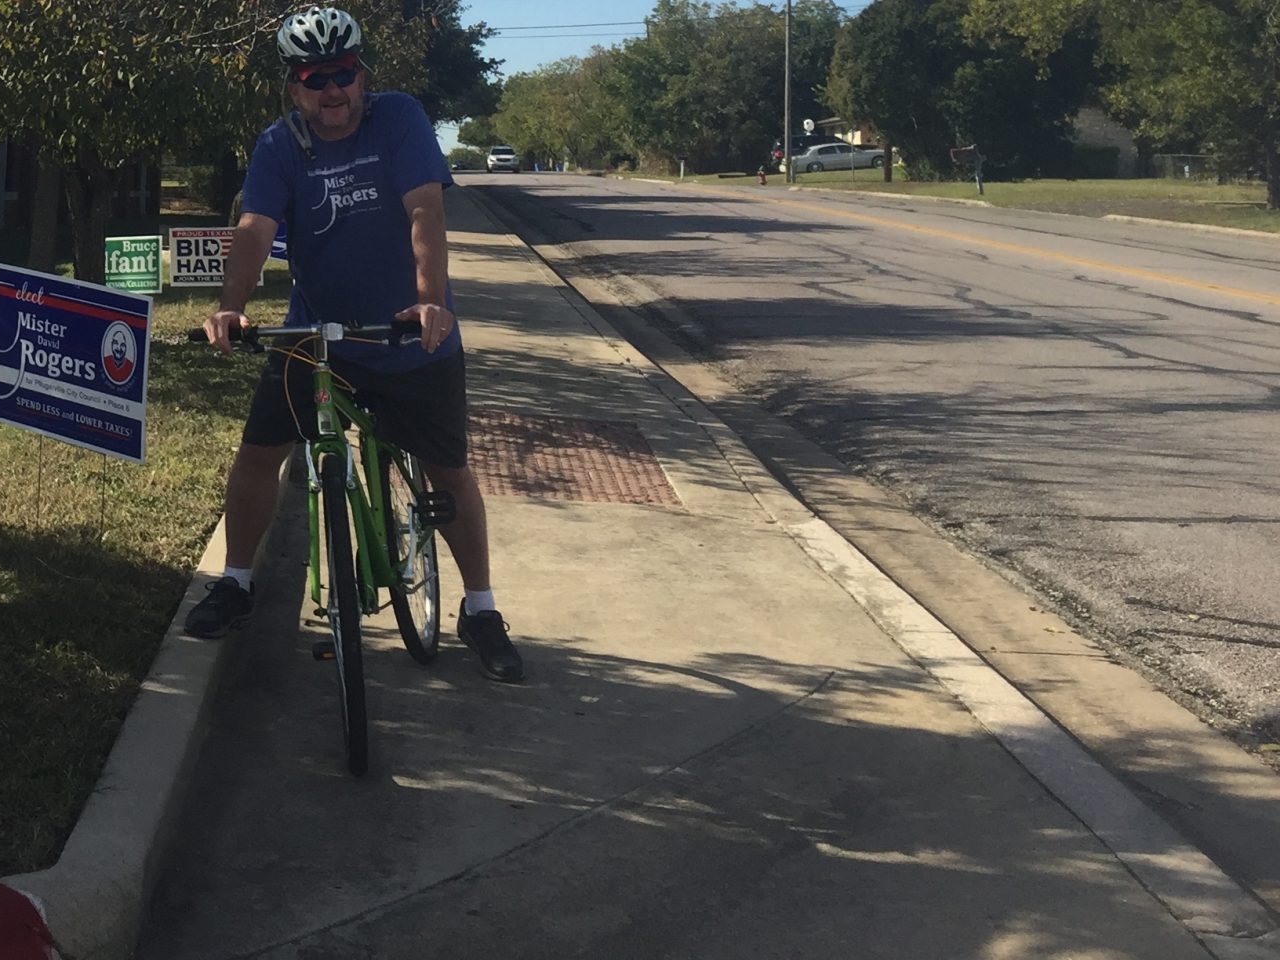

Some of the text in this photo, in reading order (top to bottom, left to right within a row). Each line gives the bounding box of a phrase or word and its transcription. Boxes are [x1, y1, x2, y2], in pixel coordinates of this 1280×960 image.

[123, 240, 157, 253] Bruce
[105, 250, 157, 274] lfant
[177, 258, 225, 273] HAR
[37, 335, 61, 350] David
[20, 338, 96, 381] Rogers
[16, 396, 41, 413] SPEND
[42, 403, 61, 417] LESS
[62, 407, 75, 421] and
[75, 413, 103, 429] LOWER
